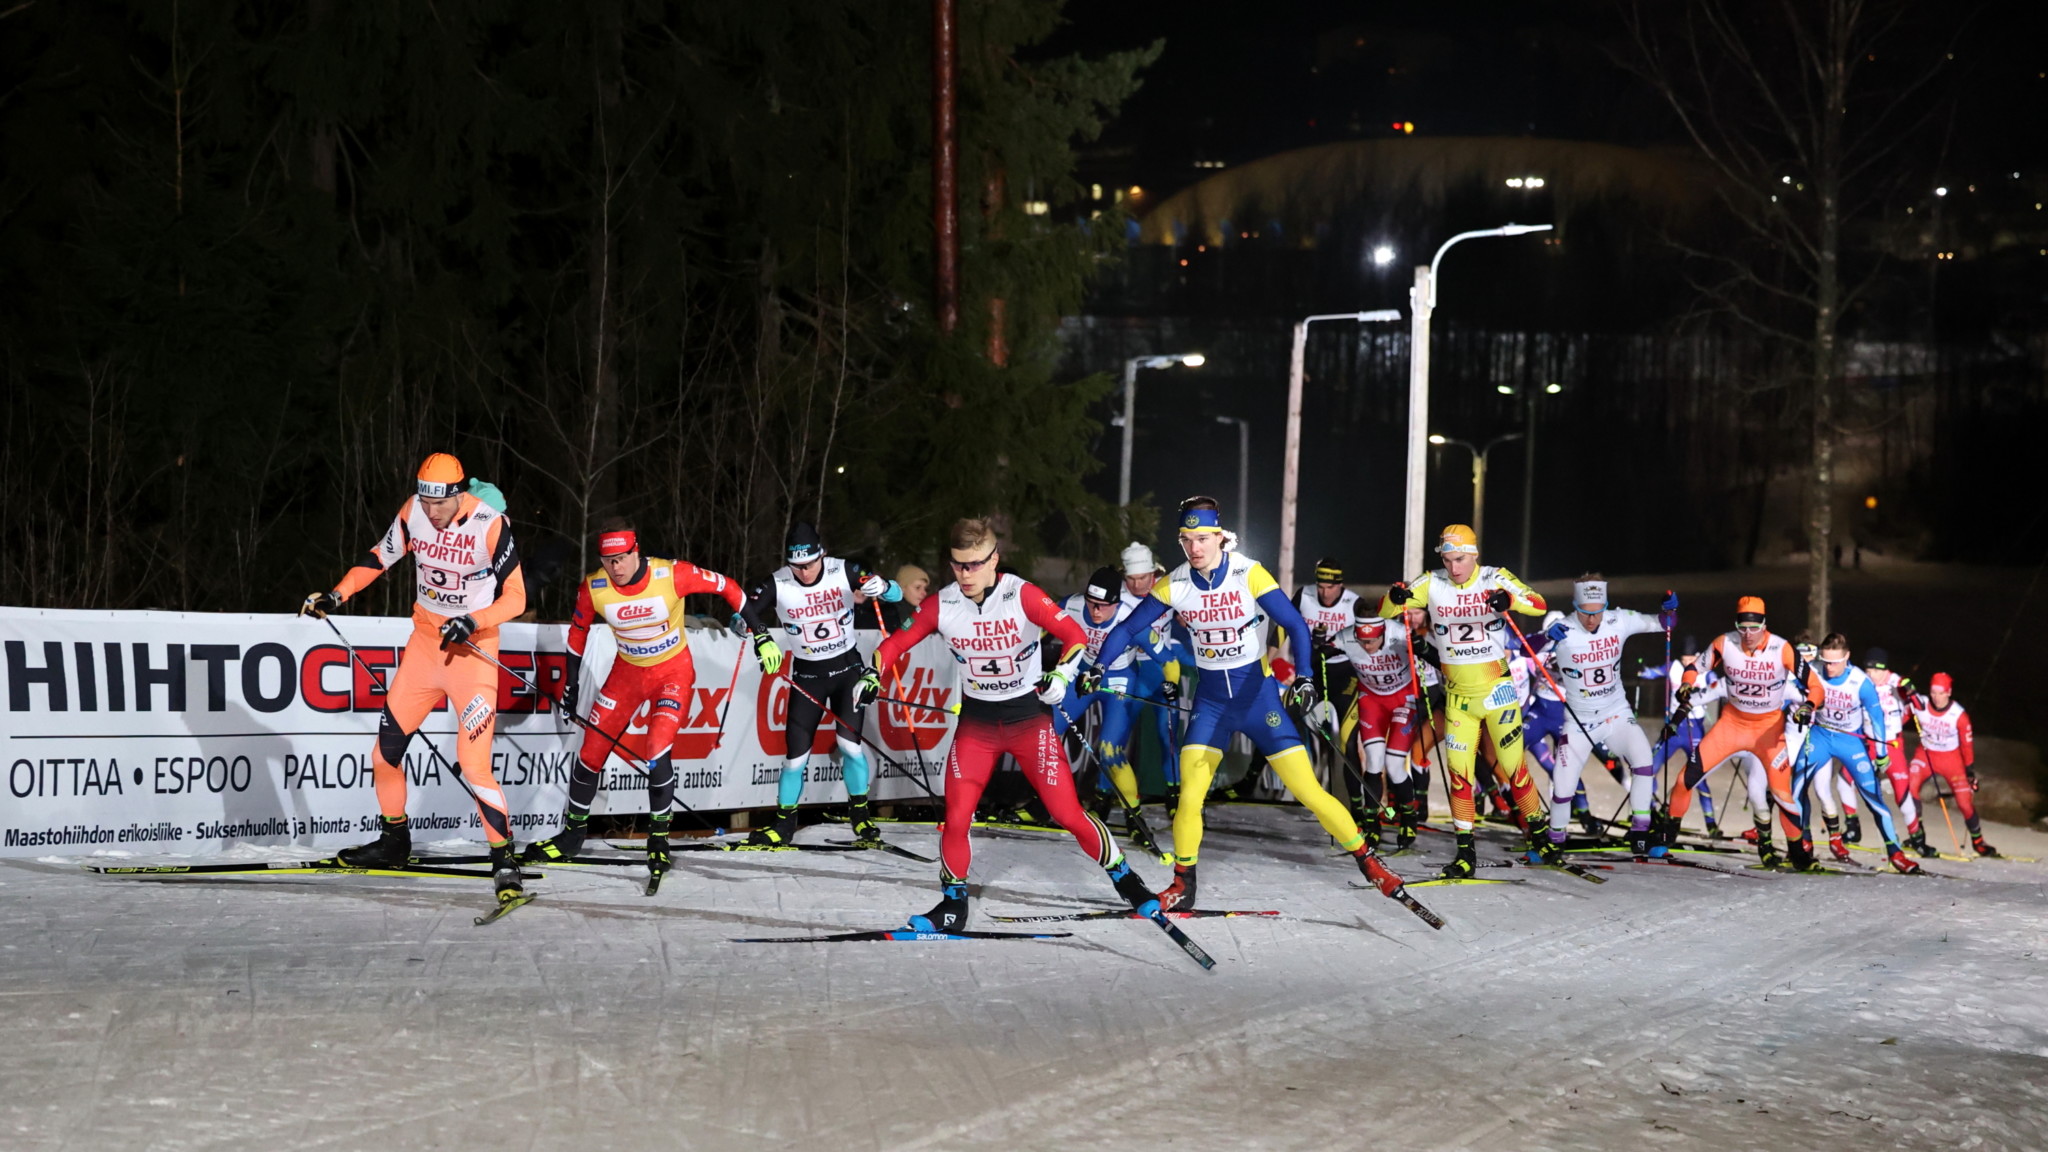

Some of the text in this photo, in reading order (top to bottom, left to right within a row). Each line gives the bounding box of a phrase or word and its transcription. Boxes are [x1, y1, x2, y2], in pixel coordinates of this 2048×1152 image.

[418, 482, 445, 495] MI.FI
[436, 529, 476, 550] TEAM
[411, 537, 476, 565] SPORTIA
[431, 570, 447, 586] 3
[462, 581, 466, 590] 1
[805, 587, 843, 605] TEAM
[1201, 591, 1242, 608] TEAM
[1457, 590, 1490, 605] TEAM
[617, 605, 655, 621] Calix
[787, 599, 845, 619] SPORTIA
[1181, 605, 1245, 623] SPORTIA
[1318, 611, 1346, 622] TEAM
[1437, 605, 1493, 617] SPORTIA
[814, 623, 830, 639] 6
[973, 618, 1018, 636] TEAM
[1458, 624, 1474, 641] 2
[811, 638, 848, 654] weber
[951, 636, 1022, 651] SPORTIA
[1453, 646, 1493, 656] weber
[1589, 635, 1620, 652] TEAM
[1370, 654, 1401, 664] TEAM
[1572, 647, 1620, 664] SPORTIA
[981, 659, 1001, 674] 4
[1016, 664, 1021, 672] 1
[1354, 662, 1403, 671] SPORTIA
[1726, 666, 1775, 680] SPORTIA
[1745, 660, 1774, 671] TEAM
[5, 640, 568, 713] HIIHTOCEER
[976, 678, 1024, 691] weber
[1372, 674, 1394, 685] 18
[1593, 669, 1606, 684] 8
[1587, 685, 1616, 697] weber
[1739, 684, 1762, 696] 22
[1826, 688, 1852, 701] TEAM
[461, 695, 484, 722] JAMI.FI
[465, 707, 489, 731] VIIMA
[9, 745, 575, 798] OITTAA ESPOO PALOHNÄ ELSINKI
[684, 765, 723, 789] autosi
[813, 763, 845, 783] autos
[4, 824, 115, 847] Maastohiihdon
[118, 822, 183, 843] erikoisliike
[195, 818, 289, 839] Suksenhuollot
[293, 816, 313, 838] ja
[315, 813, 351, 834] hionta
[359, 812, 462, 832] Sukvuokraus
[546, 813, 559, 828] 24
